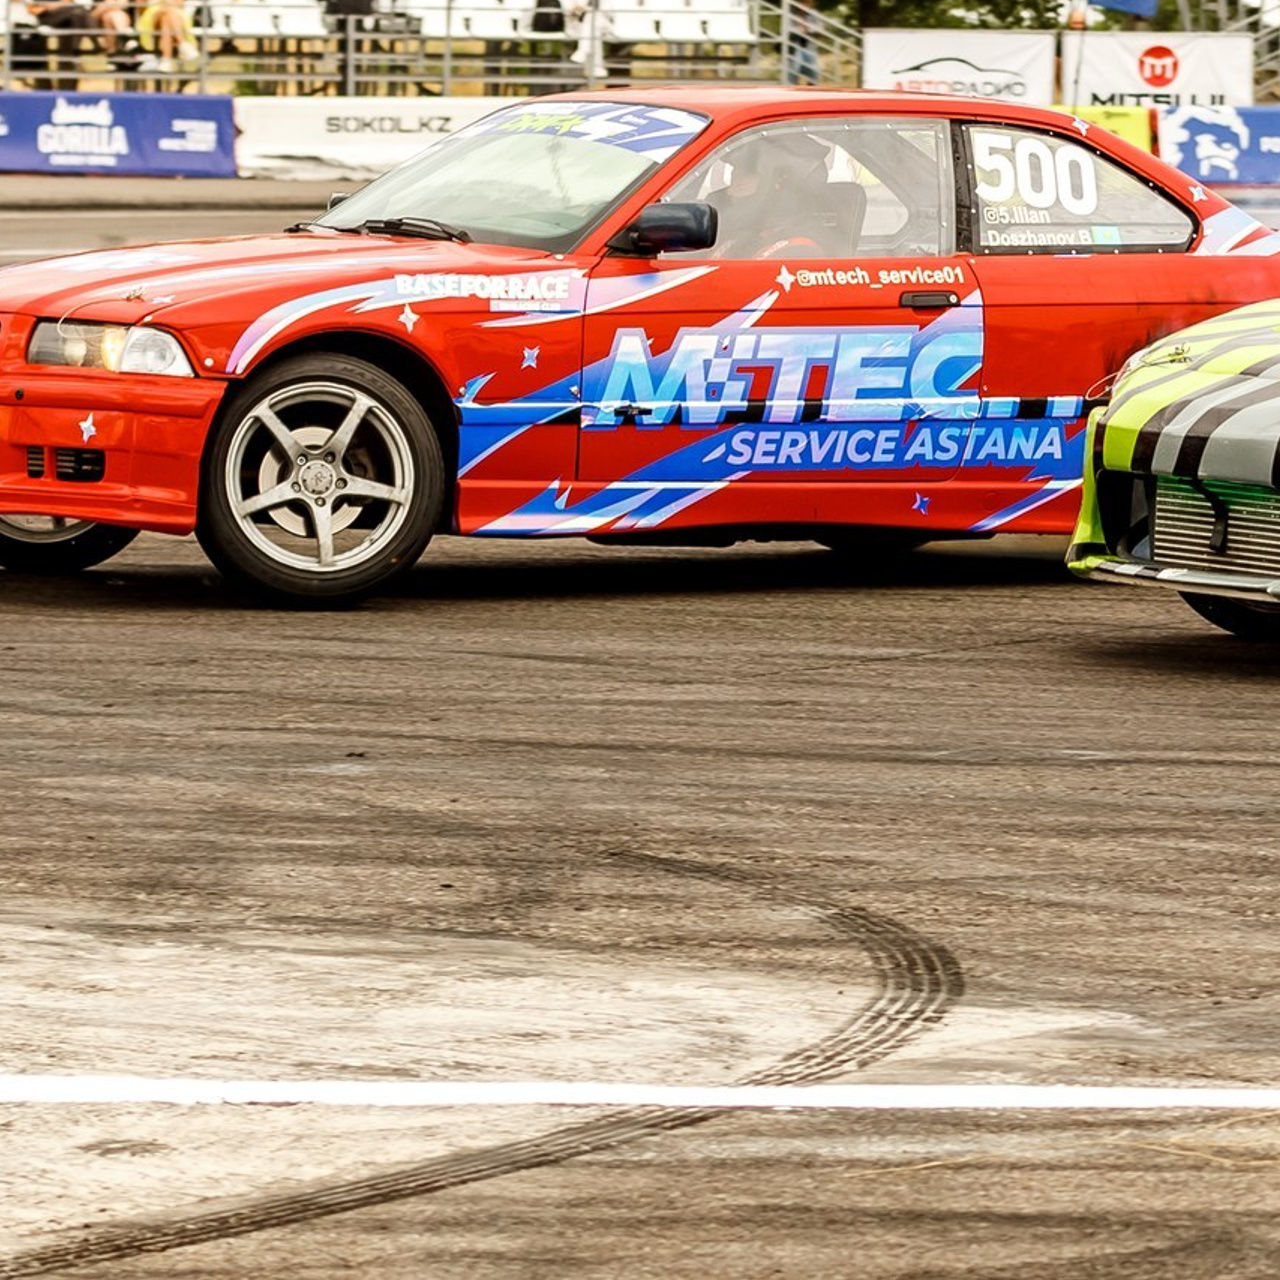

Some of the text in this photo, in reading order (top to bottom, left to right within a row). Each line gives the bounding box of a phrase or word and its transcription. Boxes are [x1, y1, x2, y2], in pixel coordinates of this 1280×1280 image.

[974, 132, 1098, 215] 500
[726, 426, 1063, 465] SERVICE ASTANA
